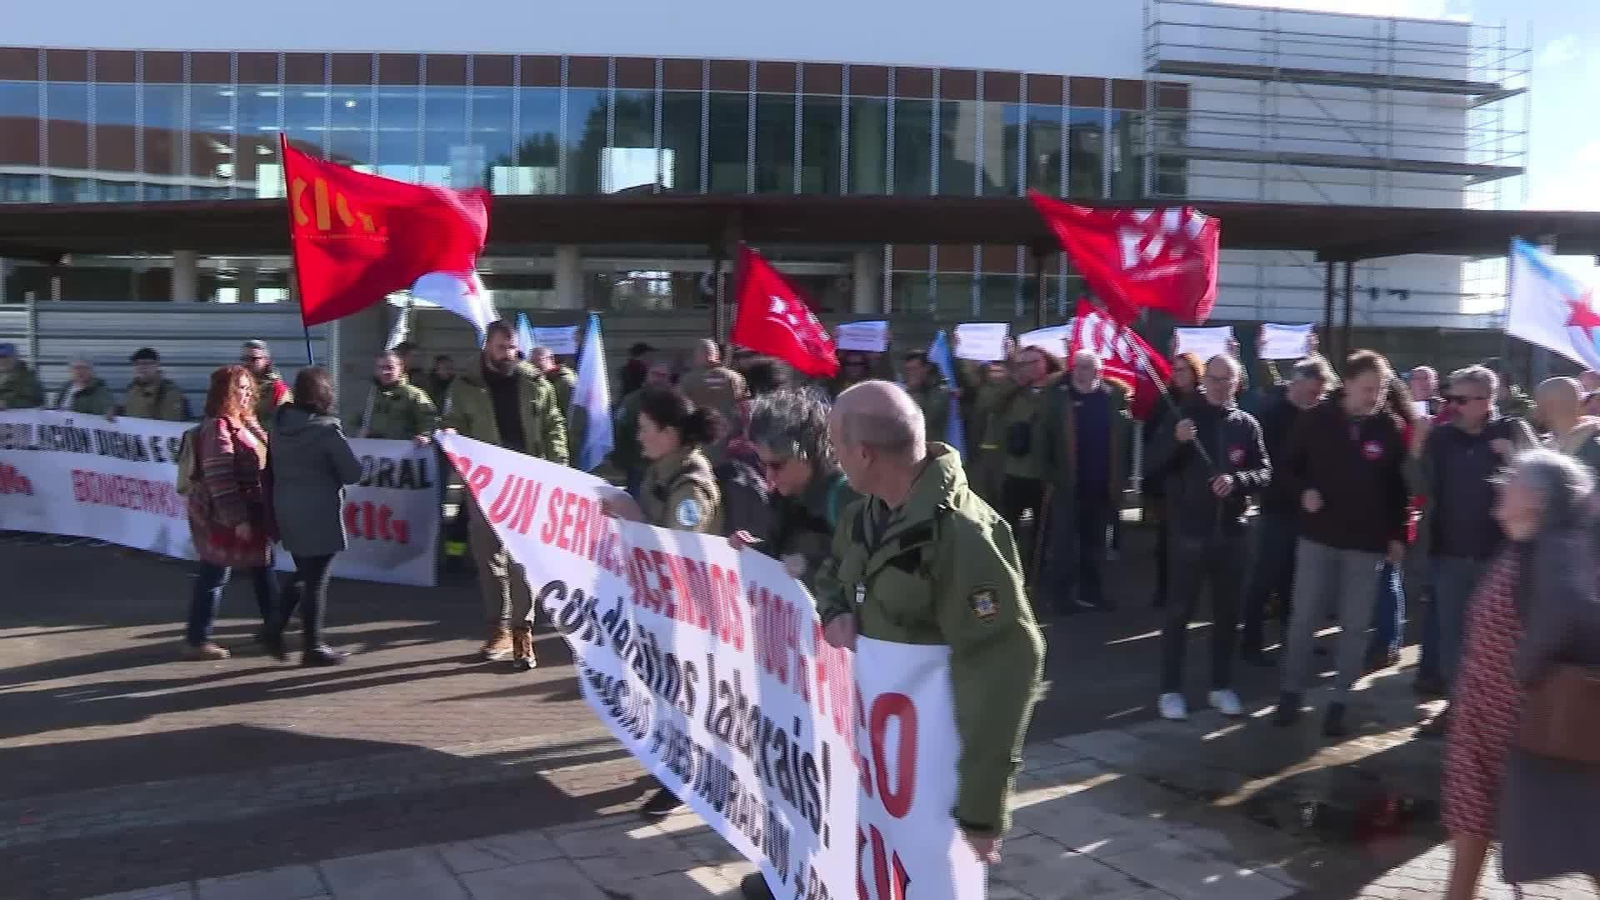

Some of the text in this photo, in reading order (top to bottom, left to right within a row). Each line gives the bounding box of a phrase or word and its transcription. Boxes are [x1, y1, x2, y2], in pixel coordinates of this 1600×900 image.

[359, 454, 434, 491] ORAL
[488, 474, 542, 534] UN
[535, 580, 604, 647] con
[704, 653, 833, 849] laborais!
